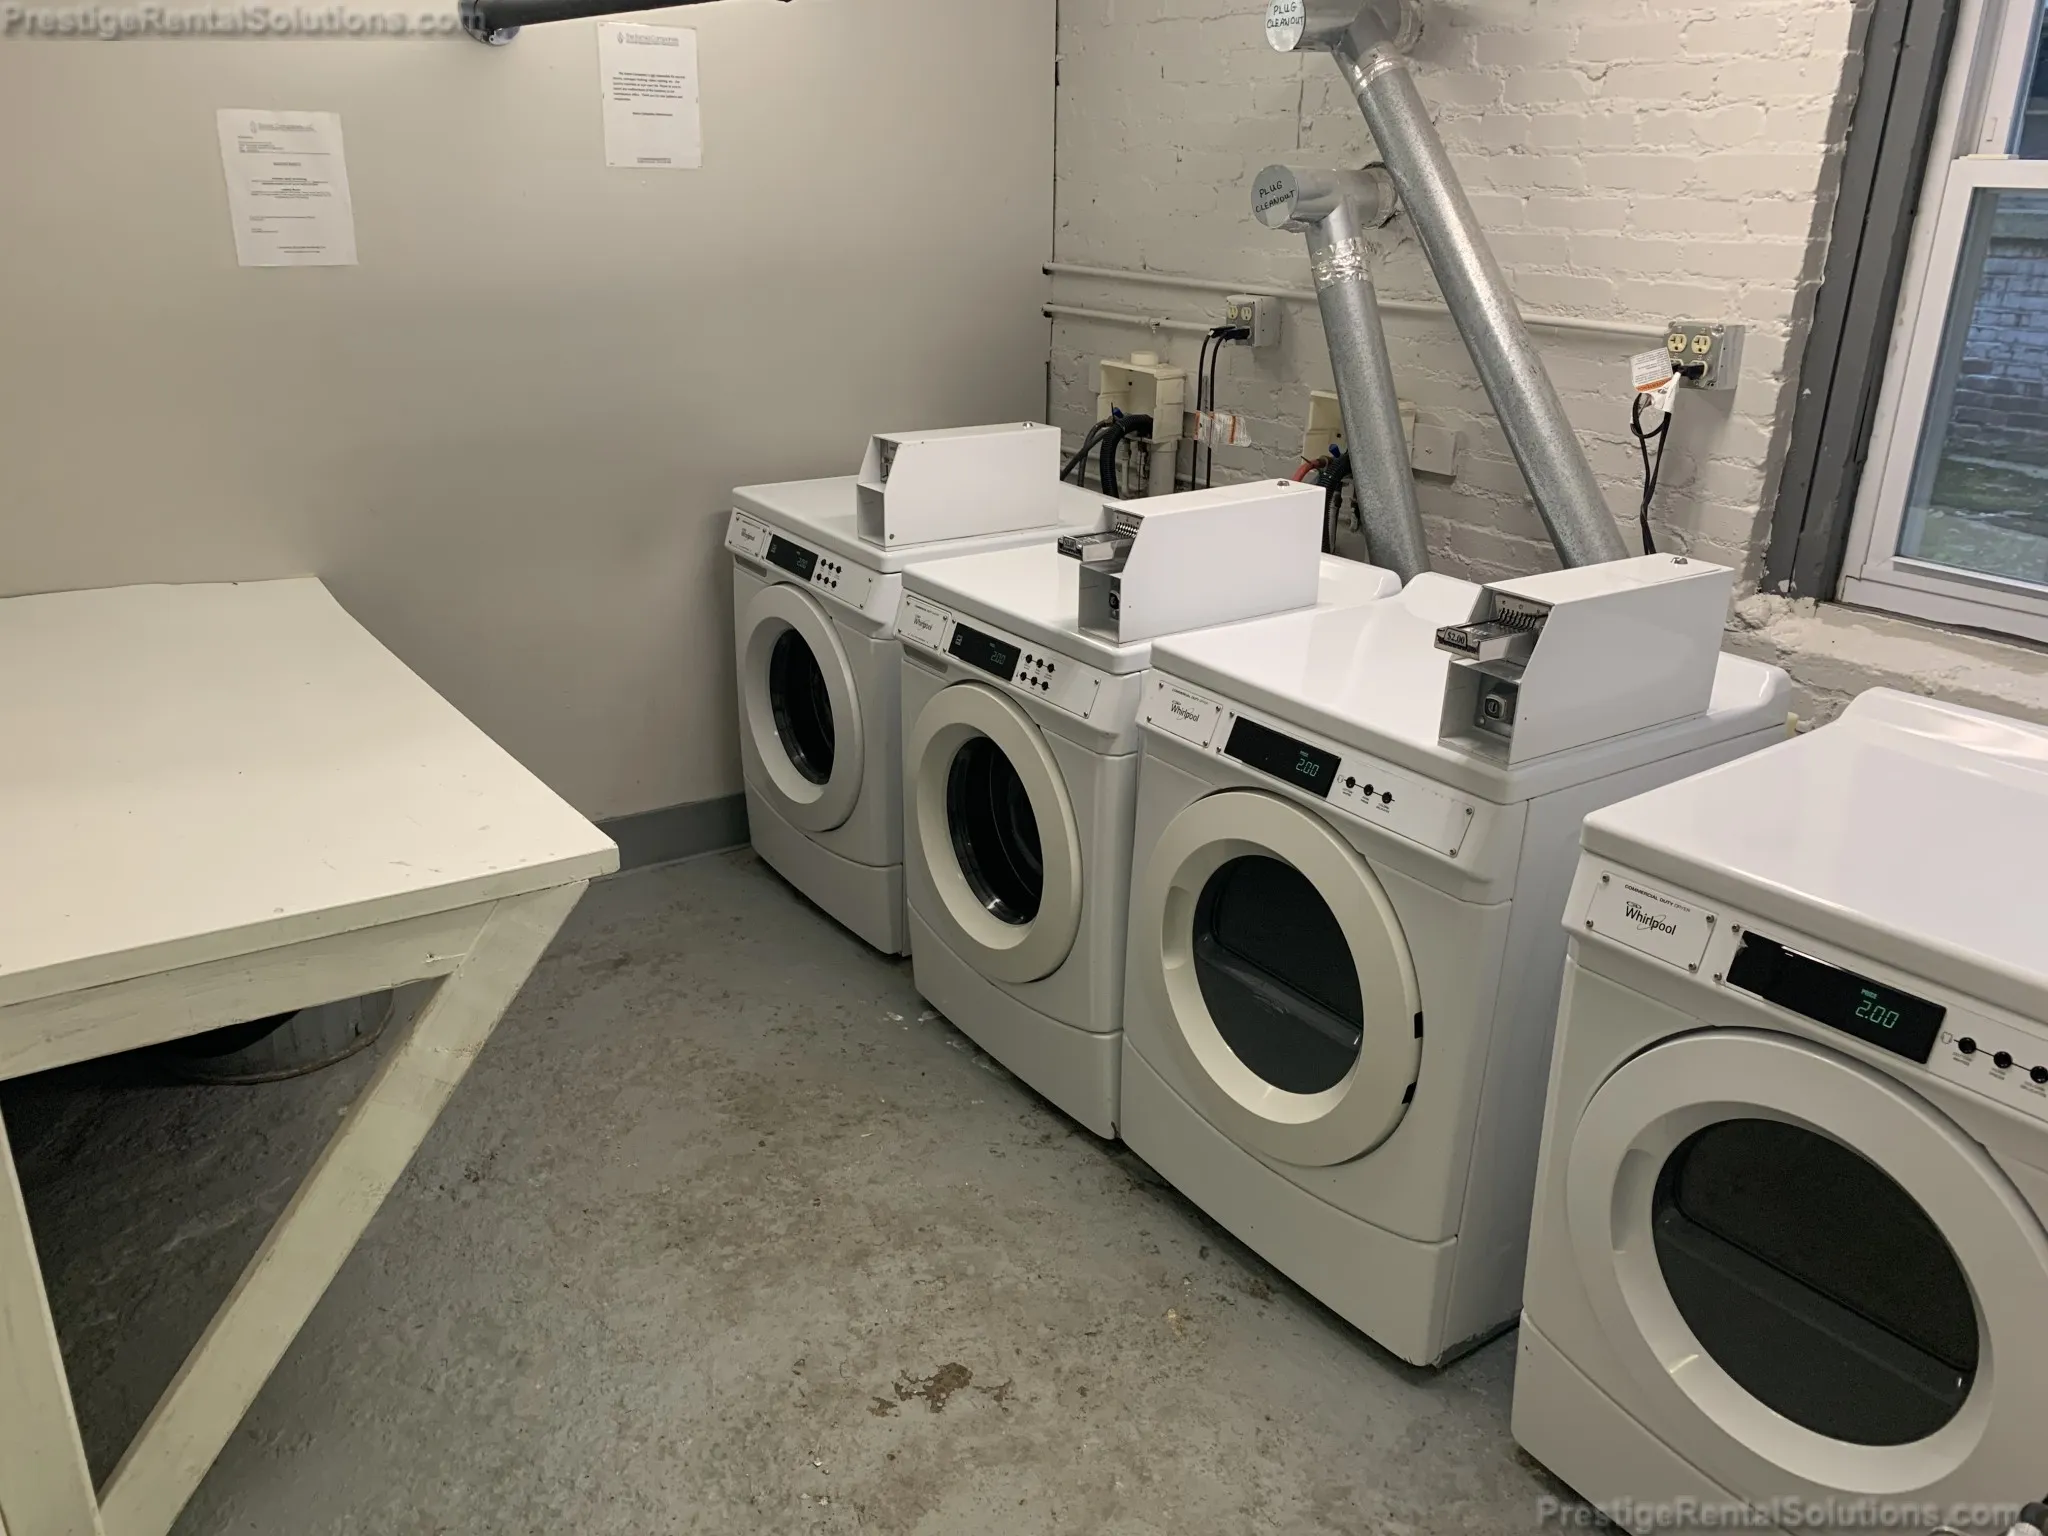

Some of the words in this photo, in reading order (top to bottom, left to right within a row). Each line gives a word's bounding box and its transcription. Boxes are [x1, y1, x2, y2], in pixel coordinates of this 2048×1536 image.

[1273, 2, 1297, 15] PLUG
[1259, 181, 1282, 198] PLUG
[1256, 190, 1295, 212] CLEANOUT
[1447, 631, 1465, 644] $2.00
[1171, 704, 1200, 722] Whirlpool
[1295, 758, 1320, 777] 2.00
[1624, 884, 1658, 901] COMMERCIAL
[1659, 897, 1674, 907] DUTY
[1625, 905, 1677, 936] Whirlpool
[1855, 1000, 1900, 1029] 2.00
